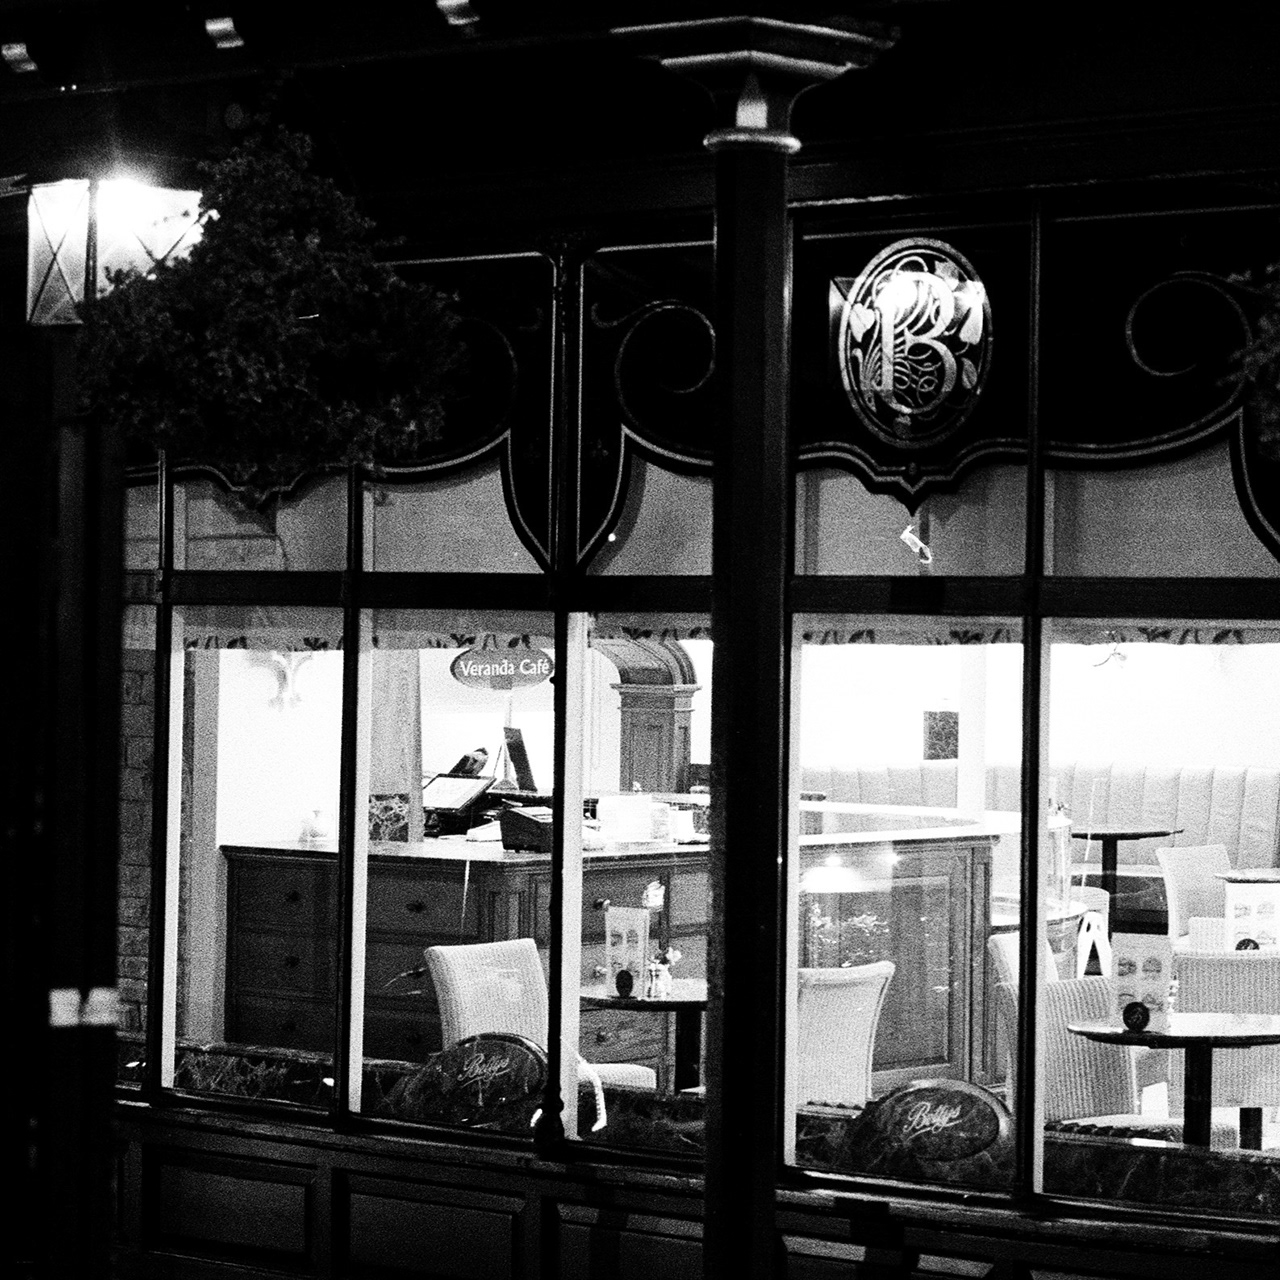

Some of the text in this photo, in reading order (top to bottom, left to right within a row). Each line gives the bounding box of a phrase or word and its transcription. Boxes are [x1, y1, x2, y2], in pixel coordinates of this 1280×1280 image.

[460, 658, 550, 676] Veranda Café
[902, 1101, 963, 1140] Bettys
